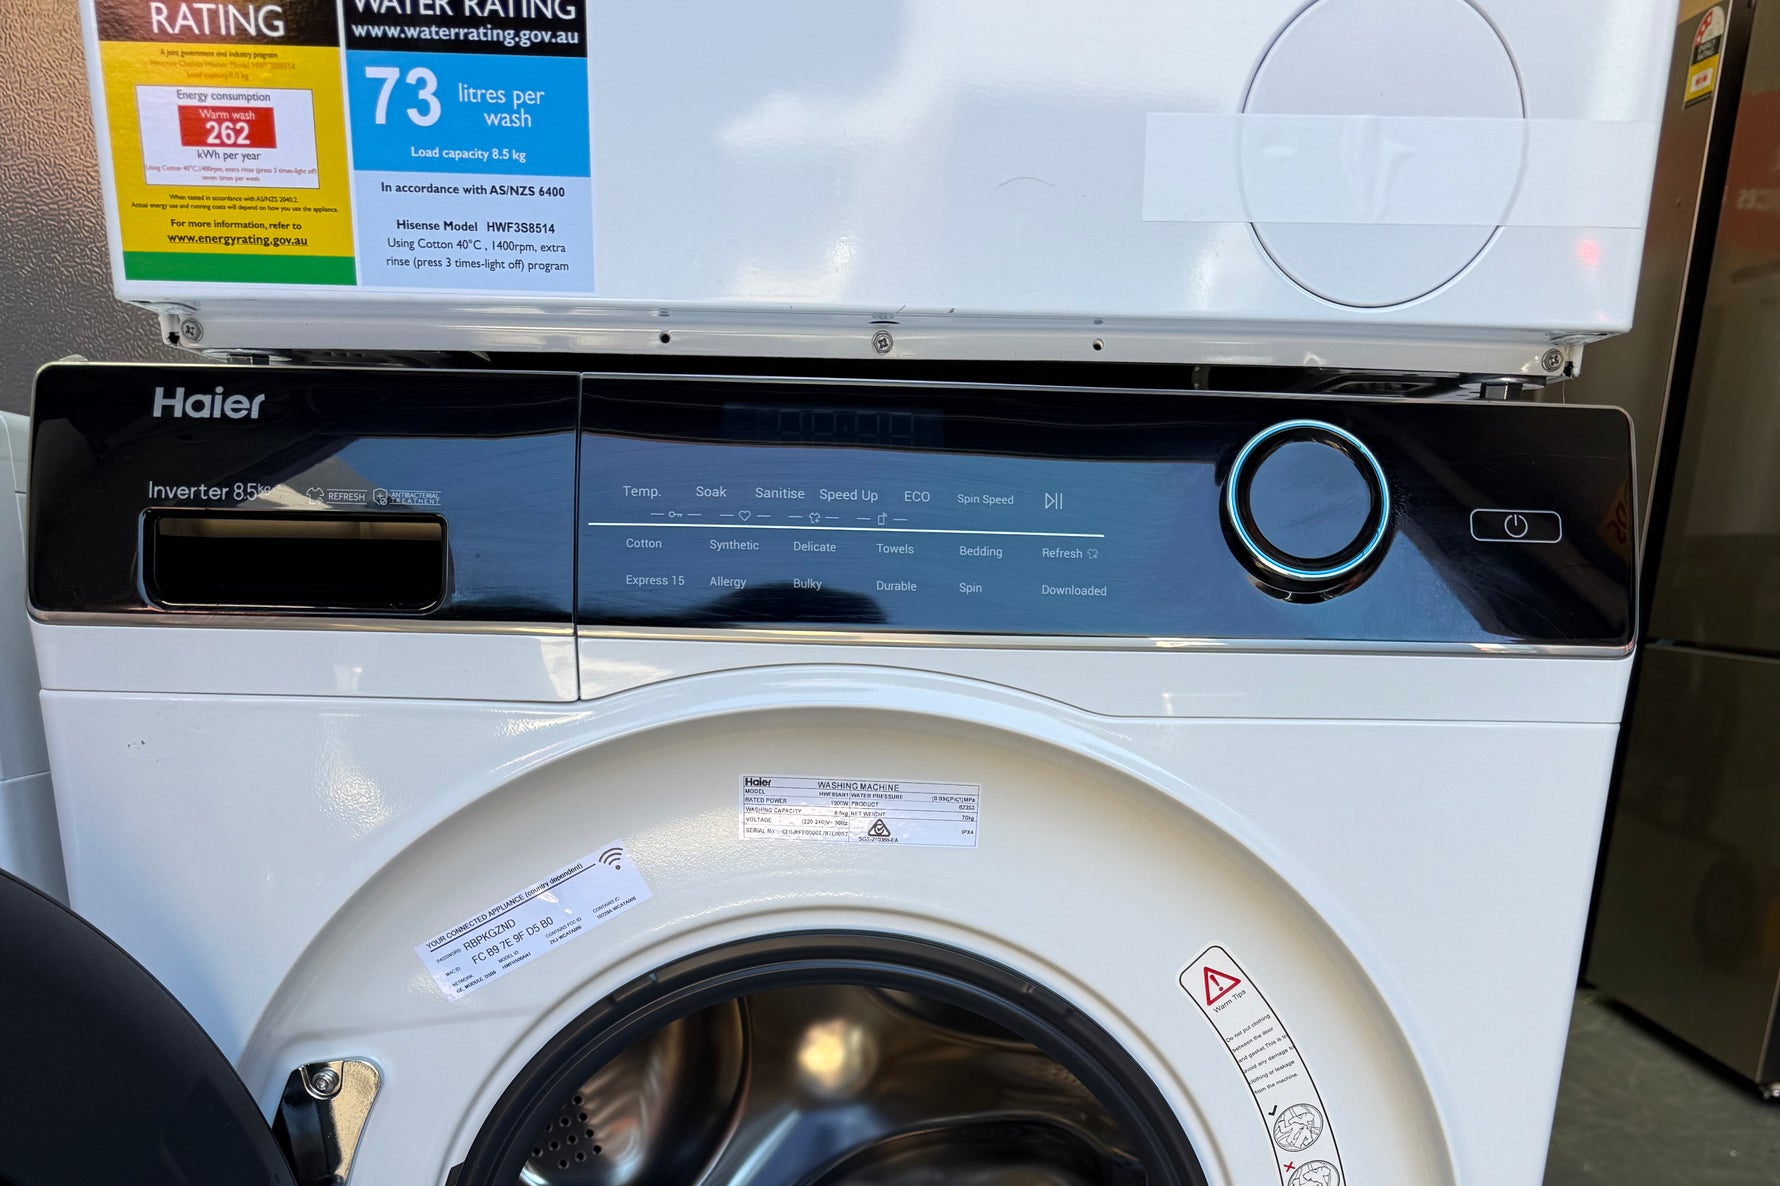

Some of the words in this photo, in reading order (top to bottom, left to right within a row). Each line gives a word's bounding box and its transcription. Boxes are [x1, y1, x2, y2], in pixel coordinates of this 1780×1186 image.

[353, 0, 458, 15] WATER
[464, 0, 576, 19] RATING
[150, 2, 286, 37] RATING
[352, 24, 579, 47] www.waterrating.gov.au
[176, 89, 208, 102] Energy
[211, 92, 271, 103] consumption
[365, 66, 442, 127] 73
[458, 82, 506, 103] litres
[513, 90, 545, 109] per
[199, 109, 230, 120] Warm
[232, 111, 256, 121] wash
[484, 109, 532, 128] wash
[205, 122, 250, 145] 262
[197, 149, 220, 160] kWh
[223, 153, 239, 162] per
[242, 153, 261, 163] year
[410, 146, 439, 158] Load
[443, 147, 489, 162] capacity
[492, 148, 509, 160] 8.5
[512, 150, 526, 163] kg
[381, 182, 392, 193] In
[395, 183, 459, 194] accordance
[463, 184, 487, 195] with
[489, 185, 535, 196] AS/NZS
[538, 186, 566, 198] 6400
[170, 219, 186, 228] For
[214, 219, 267, 231] information,
[269, 222, 290, 230] refer
[396, 219, 440, 231] Hisense
[444, 220, 478, 232] Model
[487, 221, 555, 234] HWF3S8514
[168, 233, 308, 248] www.energyrating.gov.au
[387, 237, 415, 251] Using
[418, 238, 453, 250] Cotton
[456, 239, 482, 250] 40°C
[492, 240, 537, 254] 1400rpm,
[541, 244, 566, 253] extra
[386, 257, 410, 266] rinse
[413, 257, 443, 269] (press
[446, 258, 451, 267] 3
[455, 258, 505, 272] times-light
[508, 260, 525, 272] off)
[528, 262, 569, 274] program
[153, 386, 265, 419] Haier
[149, 481, 229, 501] Inverter
[328, 492, 366, 501] REFRESH
[391, 491, 440, 499] ANTIBACTERIAL
[623, 485, 662, 500] Temp.
[696, 486, 727, 498] Soak
[755, 486, 805, 499] Sanitise
[819, 488, 858, 502] Speed
[861, 489, 878, 503] Up
[904, 490, 930, 502] ECO
[957, 494, 980, 505] Spin
[983, 495, 1014, 505] Speed
[626, 538, 662, 549] Cotton
[710, 539, 759, 552] Synthetic
[793, 541, 836, 552] Delicate
[876, 543, 914, 554] Towels
[959, 546, 1003, 559] Bedding
[1042, 548, 1083, 559] Refresh
[626, 574, 668, 587] Express
[672, 575, 685, 586] 15
[709, 576, 747, 589] Allergy
[793, 578, 822, 591] Bulky
[876, 580, 917, 592] Durable
[959, 583, 982, 594] Spin
[1042, 584, 1107, 596] Downloaded
[745, 778, 771, 787] Haier
[818, 781, 858, 790] WASHING
[860, 783, 900, 791] MACHINE
[426, 935, 446, 949] YOUR
[446, 914, 488, 939] CONNECTED
[488, 893, 525, 917] APPLIANCE
[525, 880, 549, 898] (country
[549, 863, 583, 885] dependent)
[463, 919, 516, 951] RBPKGZND
[472, 952, 487, 964] FC
[486, 944, 500, 957] B9
[499, 938, 513, 950] 7E
[513, 931, 525, 943] 9F
[526, 923, 541, 936] D5
[540, 916, 554, 929] B0
[1213, 999, 1232, 1013] Warm
[1232, 989, 1247, 1001] Tips
[1243, 1025, 1251, 1034] put
[1251, 1014, 1271, 1028] clothing
[1232, 1039, 1253, 1053] between
[1253, 1033, 1262, 1041] the
[1262, 1026, 1273, 1036] door
